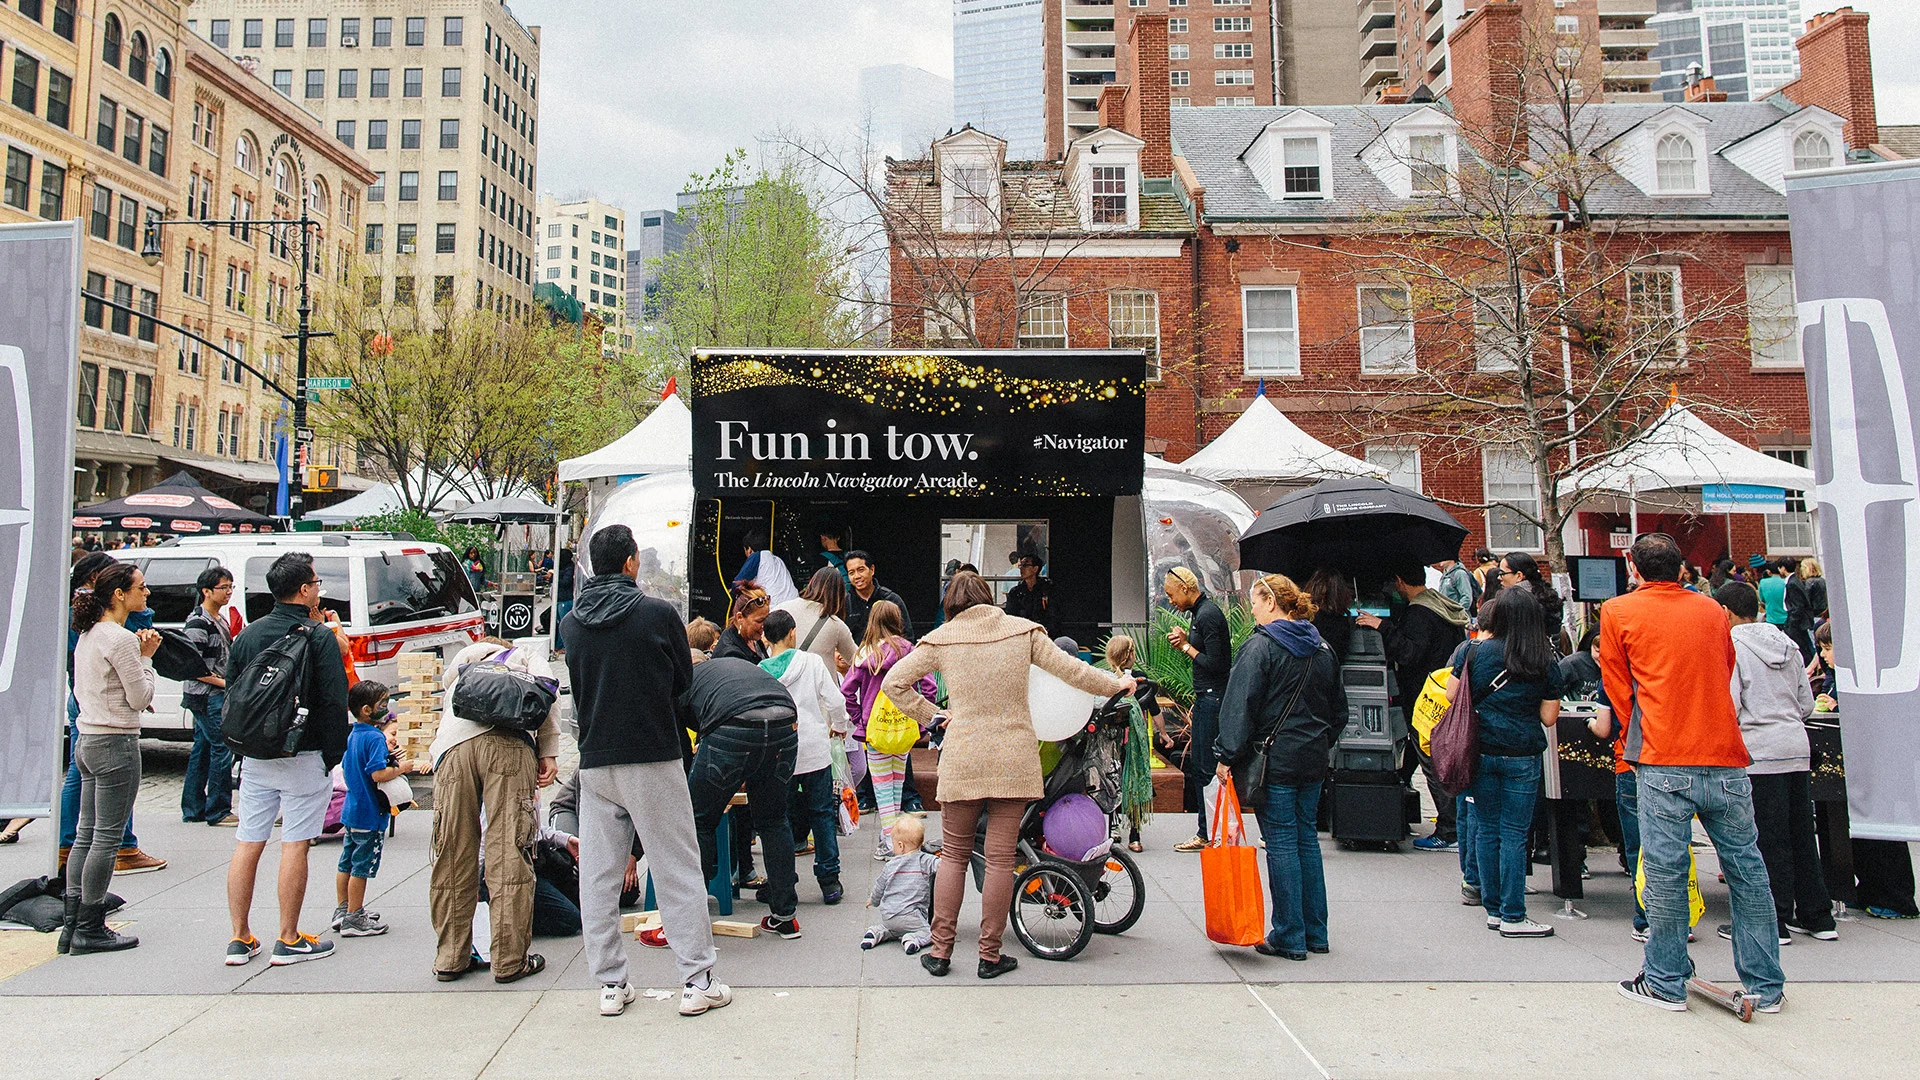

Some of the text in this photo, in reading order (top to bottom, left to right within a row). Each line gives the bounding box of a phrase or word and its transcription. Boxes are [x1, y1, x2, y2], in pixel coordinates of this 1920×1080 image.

[290, 136, 308, 196] BUILDING
[308, 379, 341, 388] HARRISON
[715, 418, 979, 461] Fun in tow.
[1033, 433, 1128, 454] #Navigator
[714, 472, 978, 492] The Lincoln Navigator Arcade
[1612, 535, 1629, 546] TEST
[509, 615, 528, 626] NY
